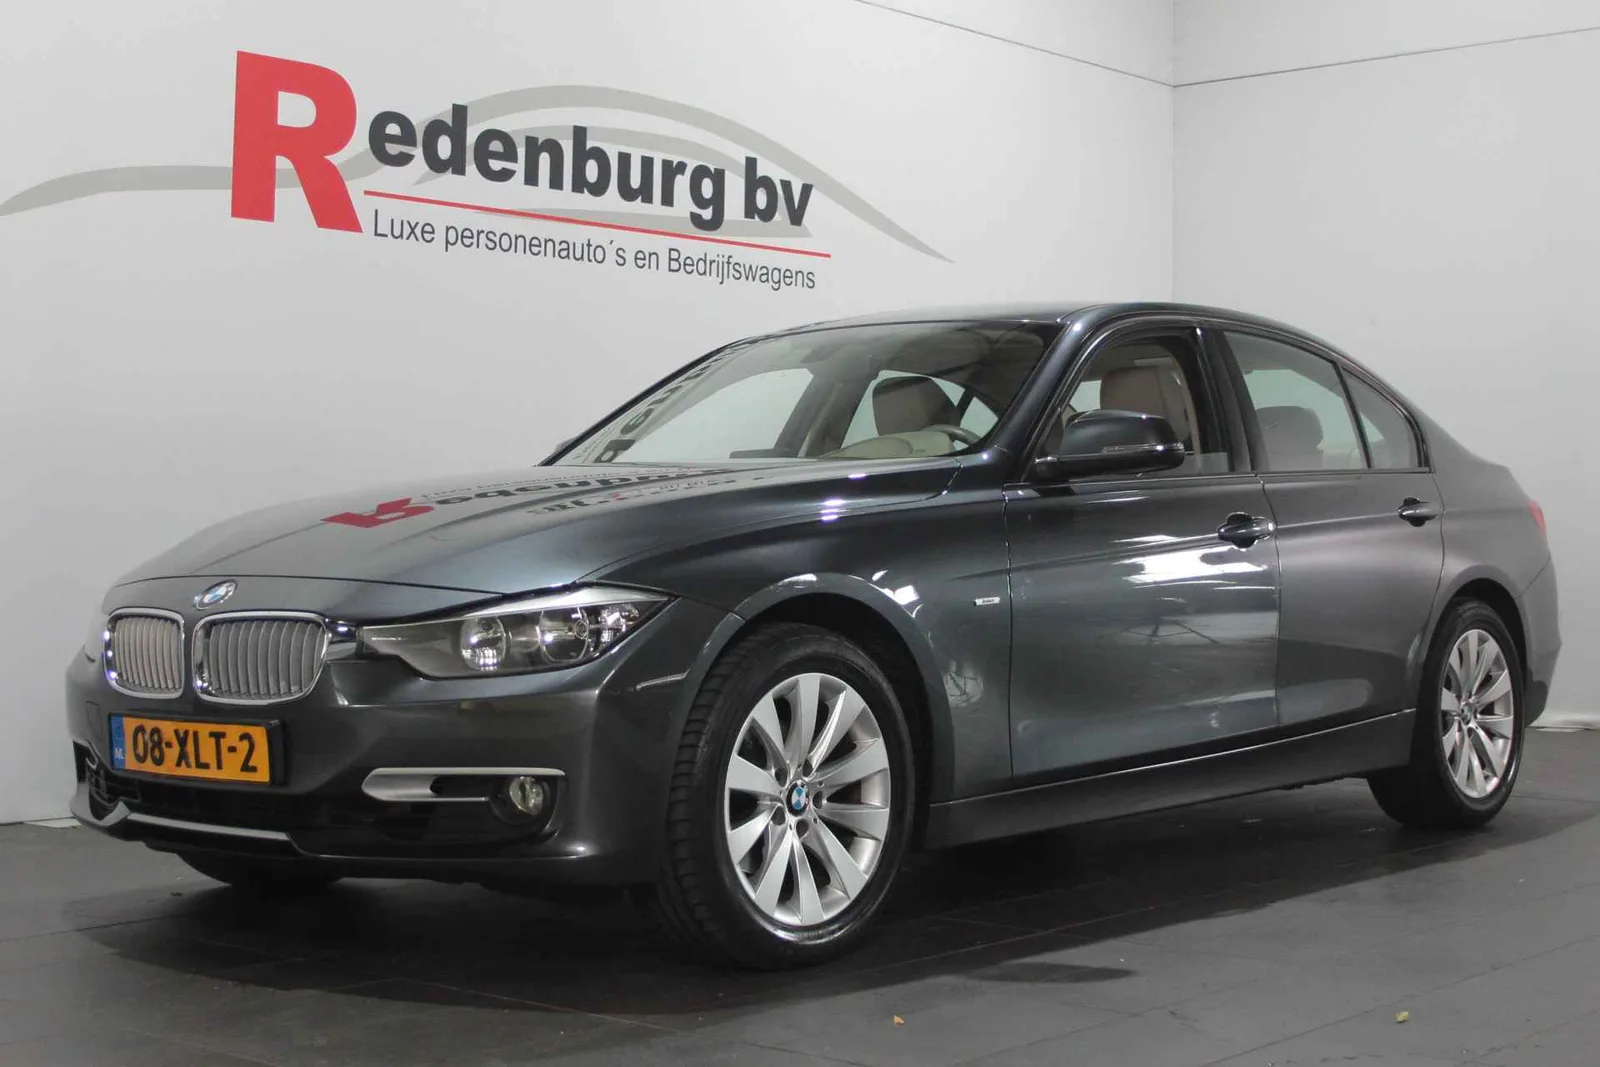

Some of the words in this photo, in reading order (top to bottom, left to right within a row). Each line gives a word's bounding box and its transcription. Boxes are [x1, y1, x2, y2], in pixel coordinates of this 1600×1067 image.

[231, 50, 726, 233] Redenburg
[743, 156, 814, 227] bv
[373, 208, 436, 243] Luxe
[634, 249, 660, 271] en
[668, 248, 816, 291] Bedrijfswagens
[132, 724, 258, 773] 08-XLT-2
